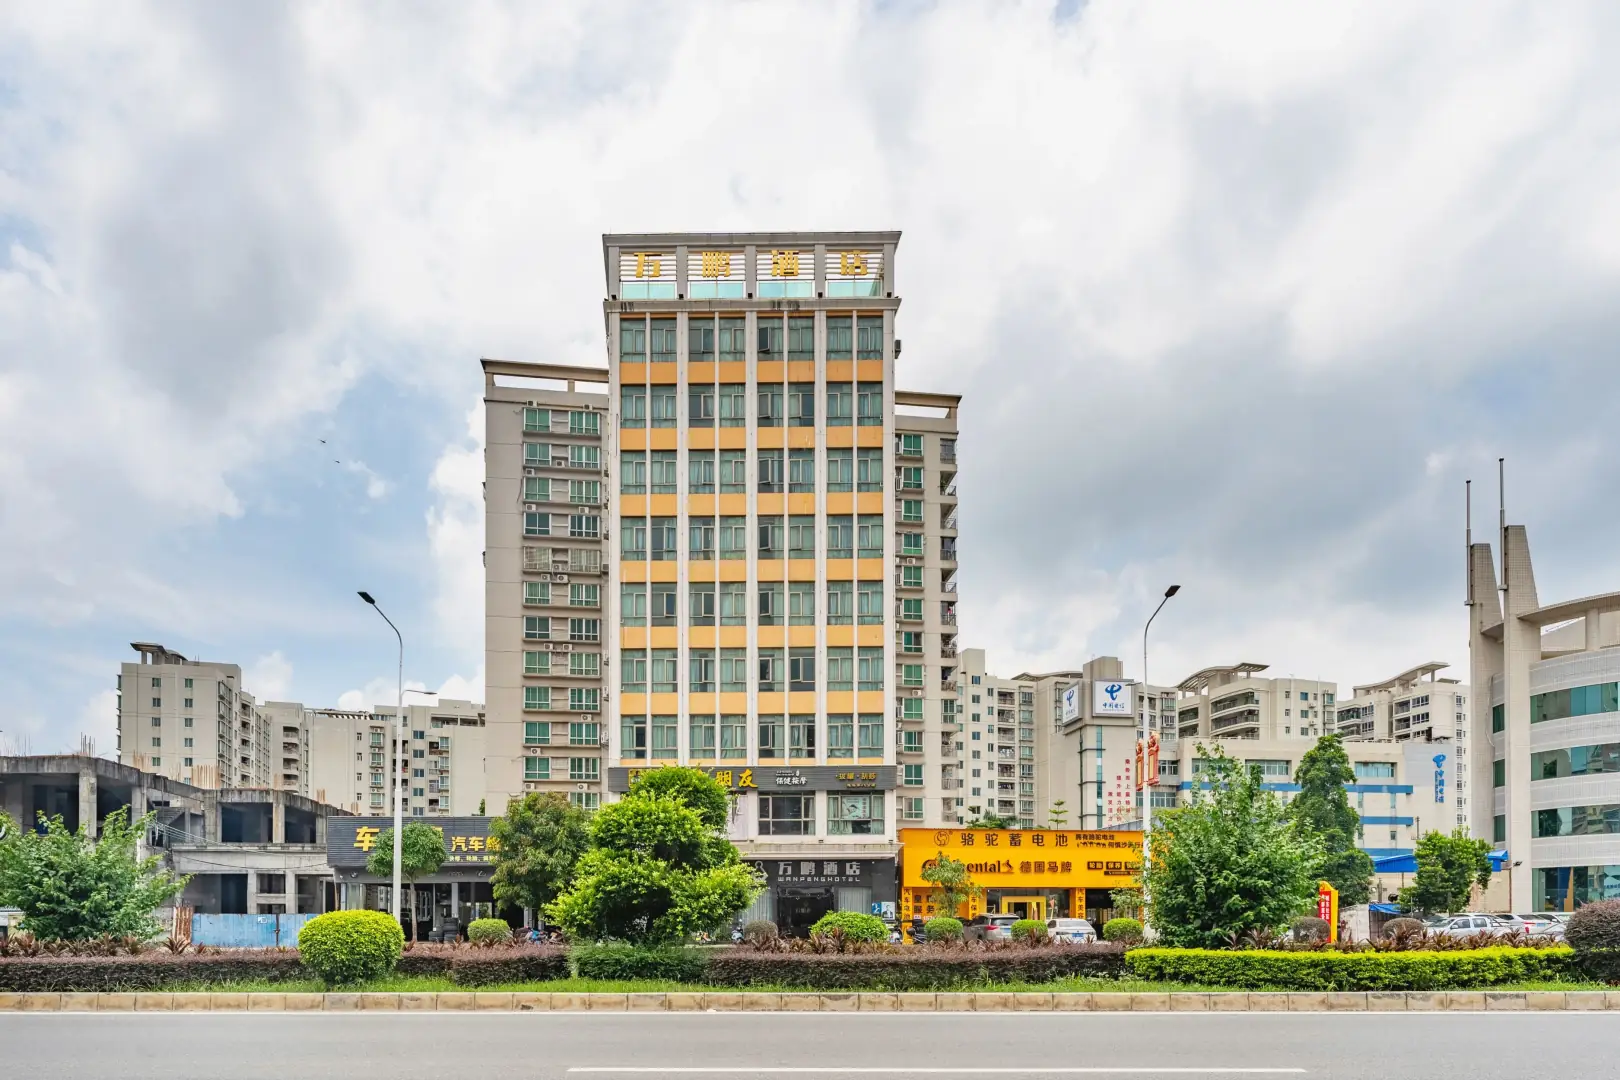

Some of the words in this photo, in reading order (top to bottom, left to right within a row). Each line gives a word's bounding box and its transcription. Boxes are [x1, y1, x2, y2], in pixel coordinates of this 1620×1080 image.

[634, 250, 868, 278] 万鹏酒店
[776, 777, 807, 785] 保健按摩
[960, 832, 1069, 847] 骆驼蓄电池
[777, 861, 861, 876] 万鹏酒店
[1019, 860, 1073, 874] 德国马牌
